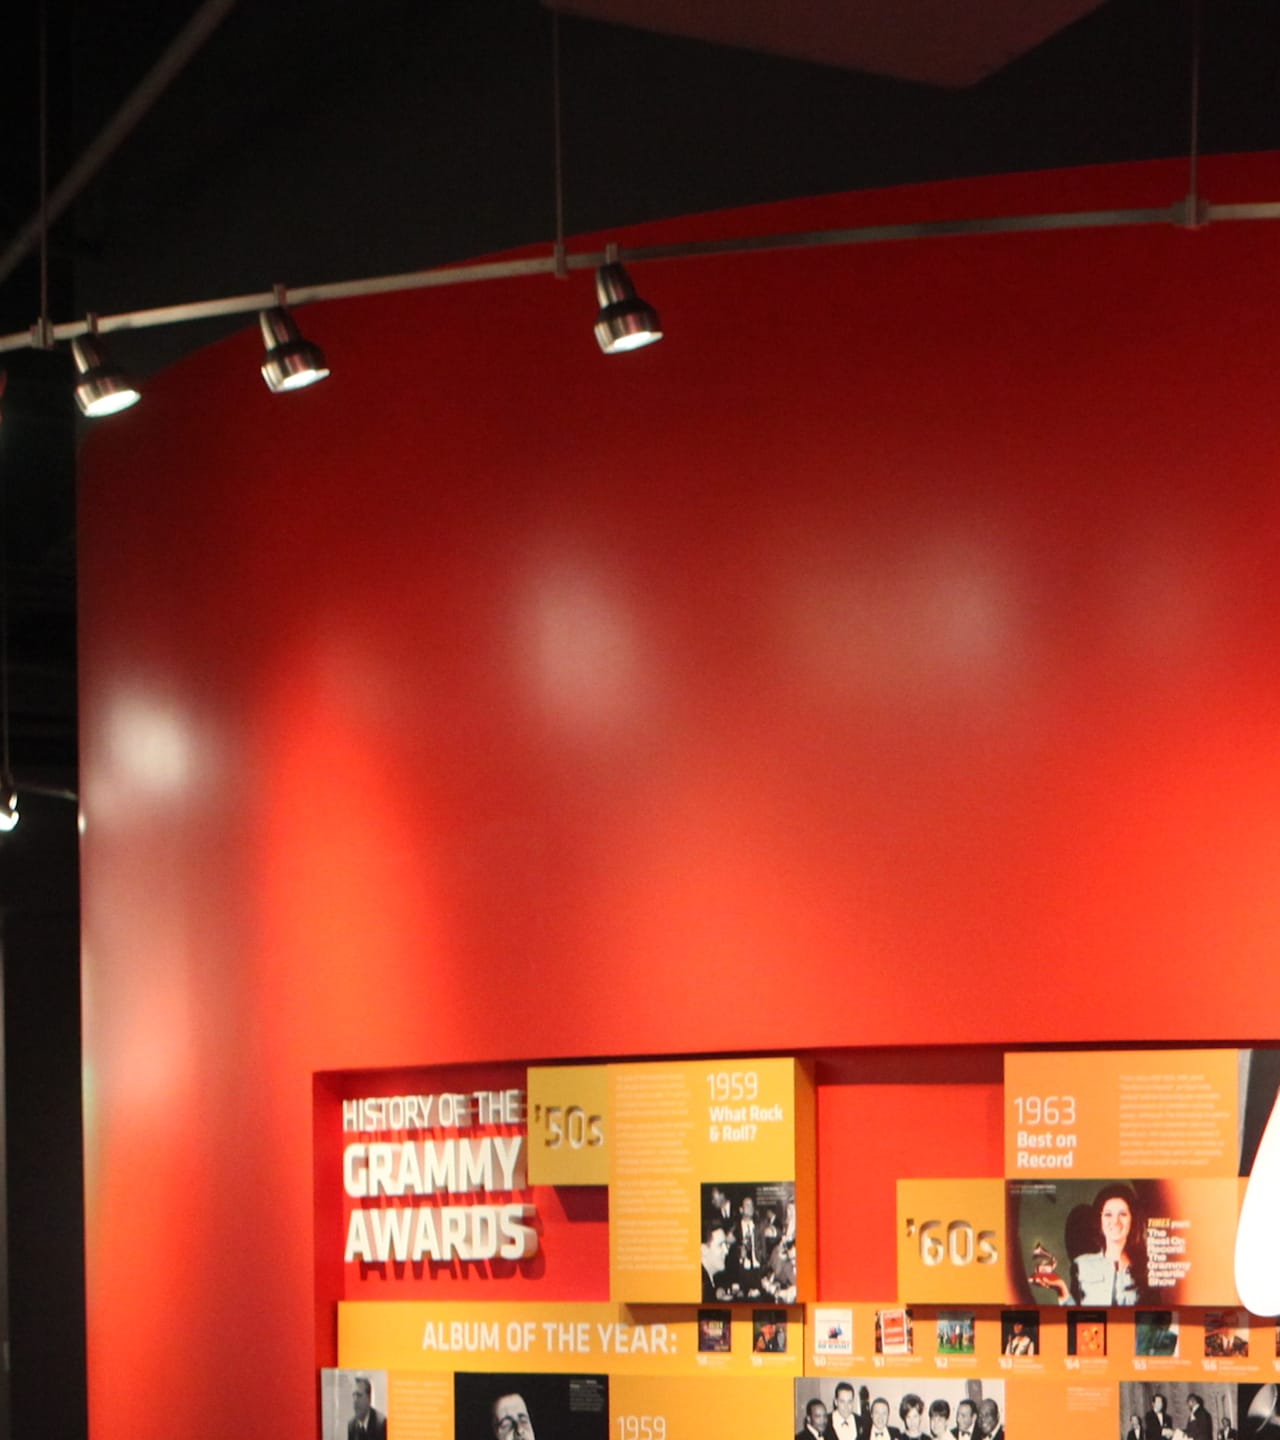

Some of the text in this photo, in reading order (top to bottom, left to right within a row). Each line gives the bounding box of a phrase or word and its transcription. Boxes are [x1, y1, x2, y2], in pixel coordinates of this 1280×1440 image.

[706, 1072, 758, 1101] 1959
[342, 1089, 520, 1131] HISTORY OF THE
[710, 1104, 783, 1122] What Rock
[1013, 1096, 1076, 1126] 1963
[534, 1104, 603, 1149] '50s
[709, 1125, 757, 1142] & Roll?
[1017, 1131, 1077, 1149] Best on
[343, 1135, 523, 1197] GRAMMY
[1017, 1152, 1073, 1168] Record
[344, 1204, 528, 1262] AWARDS
[906, 1217, 998, 1267] '60s
[422, 1322, 677, 1353] ALBUM OF THE YEAR:
